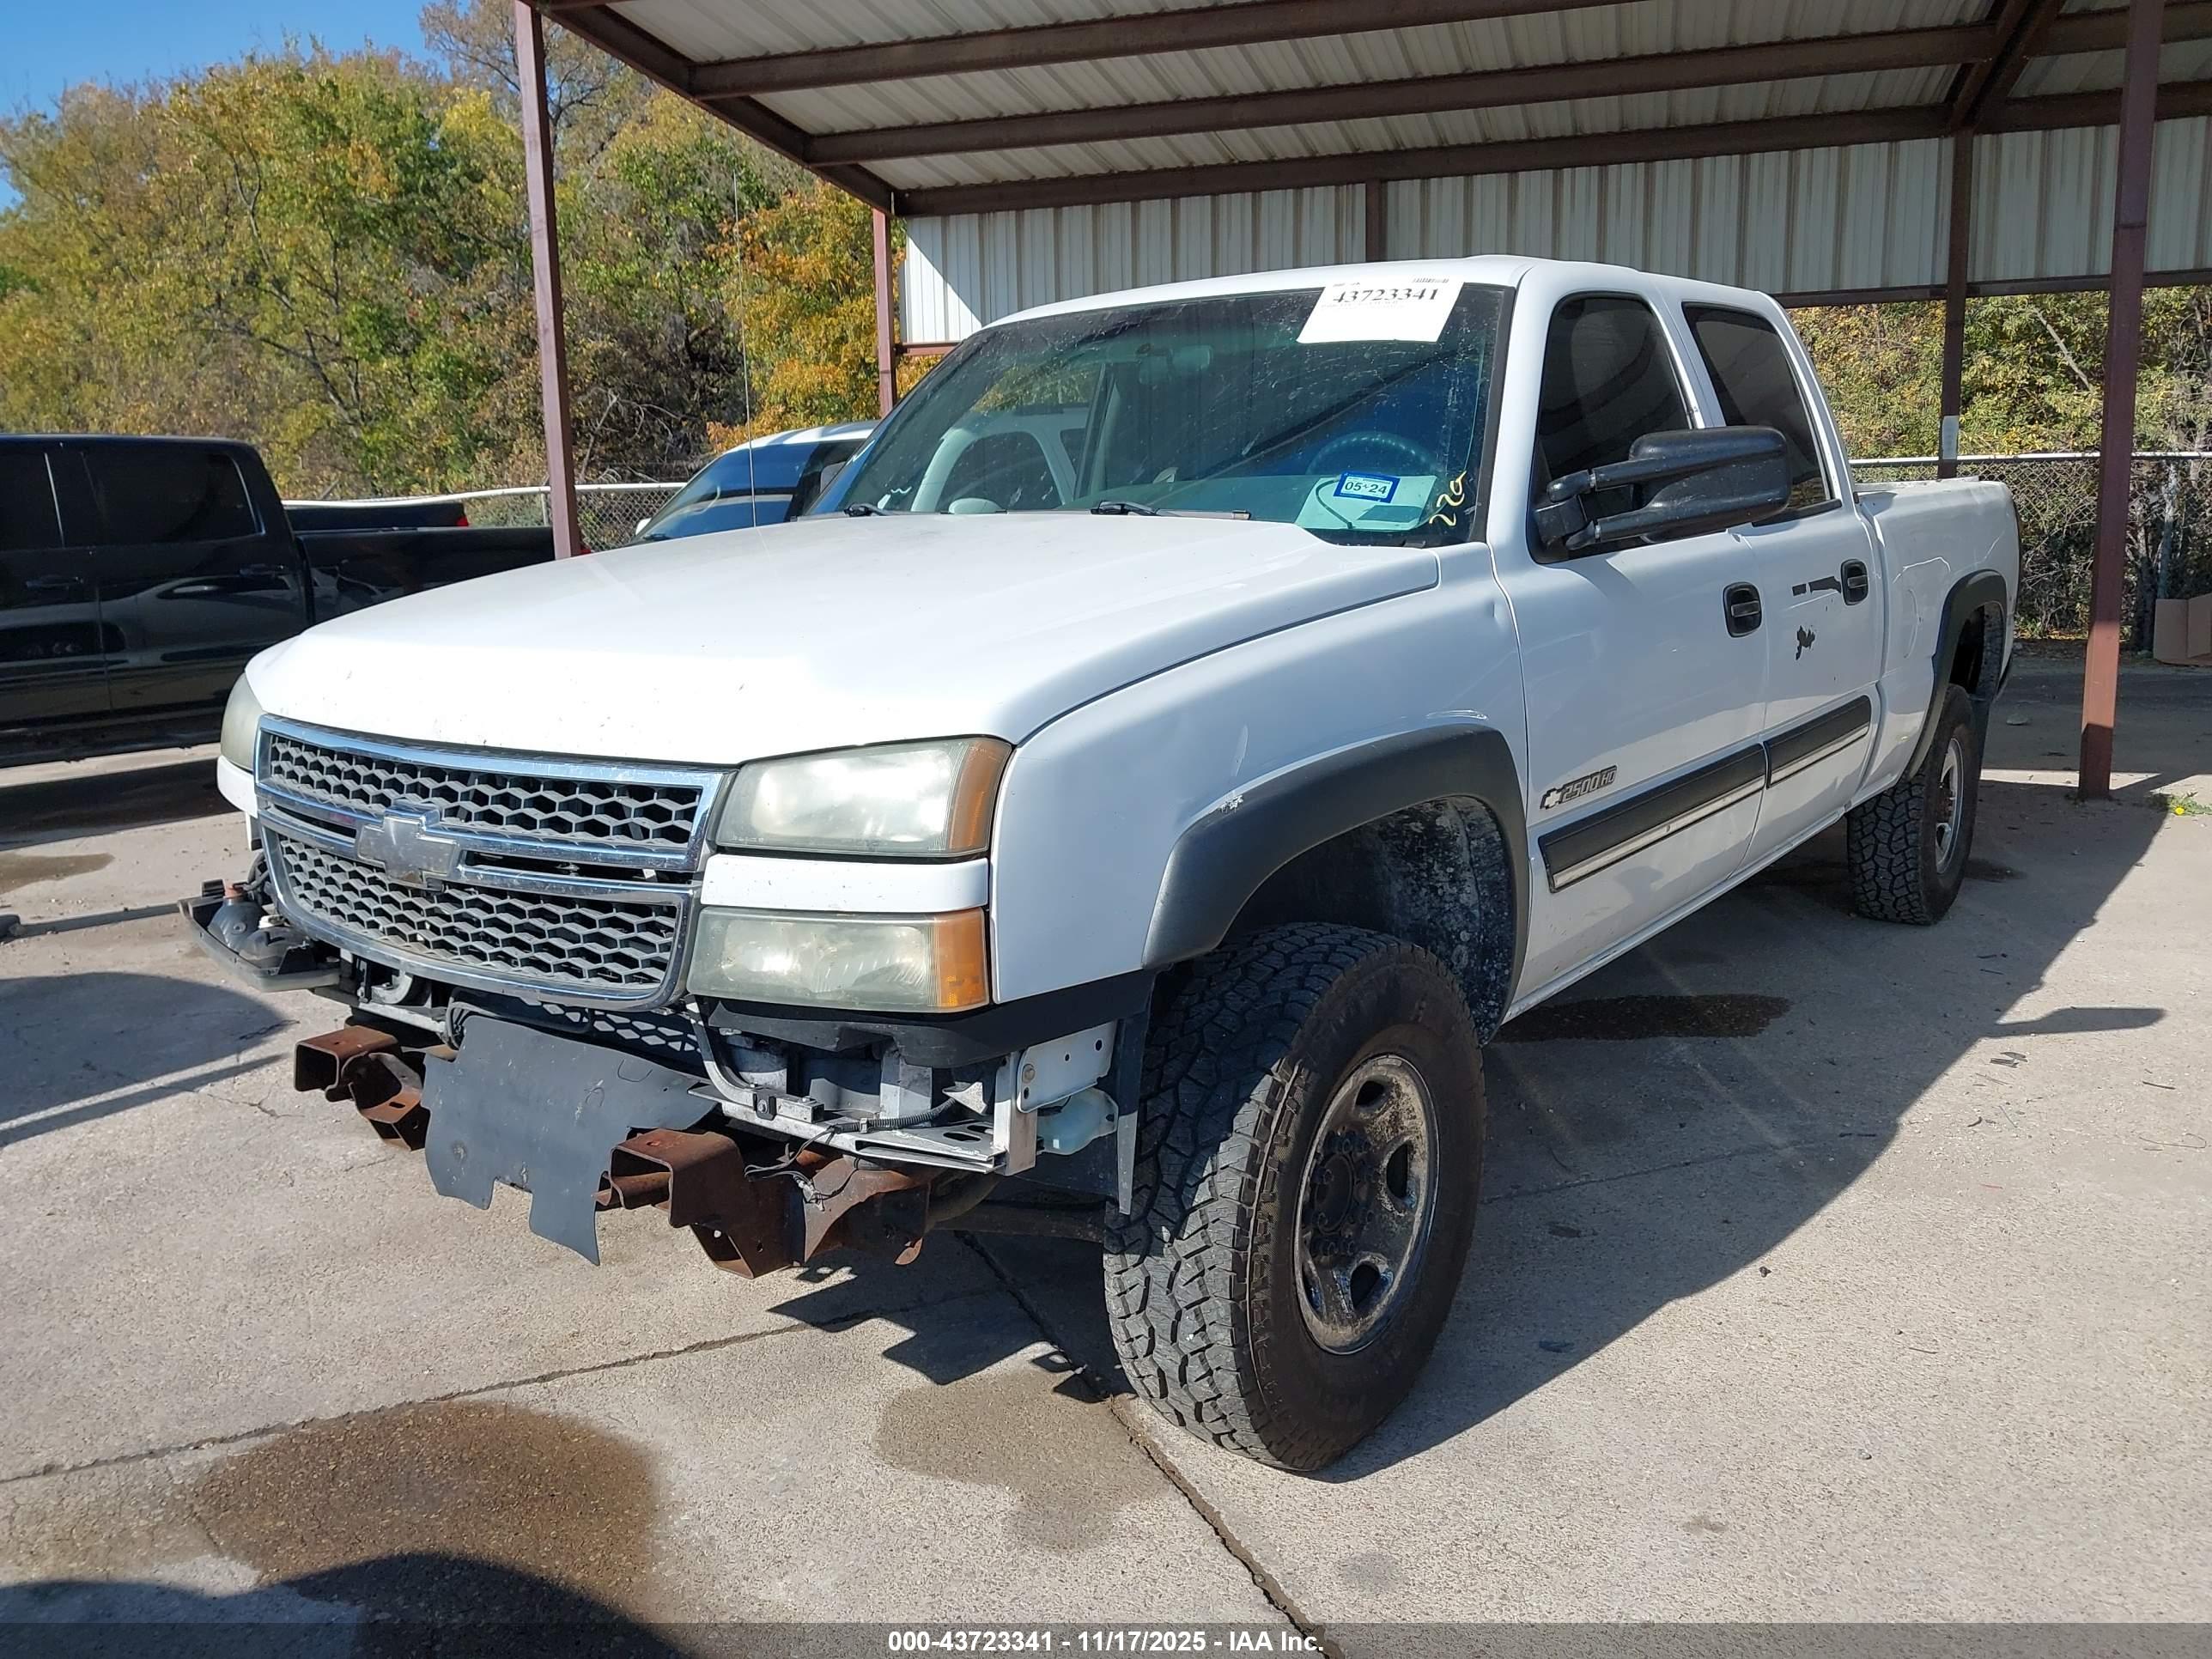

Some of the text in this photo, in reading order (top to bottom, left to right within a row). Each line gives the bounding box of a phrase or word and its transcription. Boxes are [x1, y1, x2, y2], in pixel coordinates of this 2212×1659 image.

[1332, 288, 1439, 303] 43723341
[1345, 481, 1388, 495] 05 24
